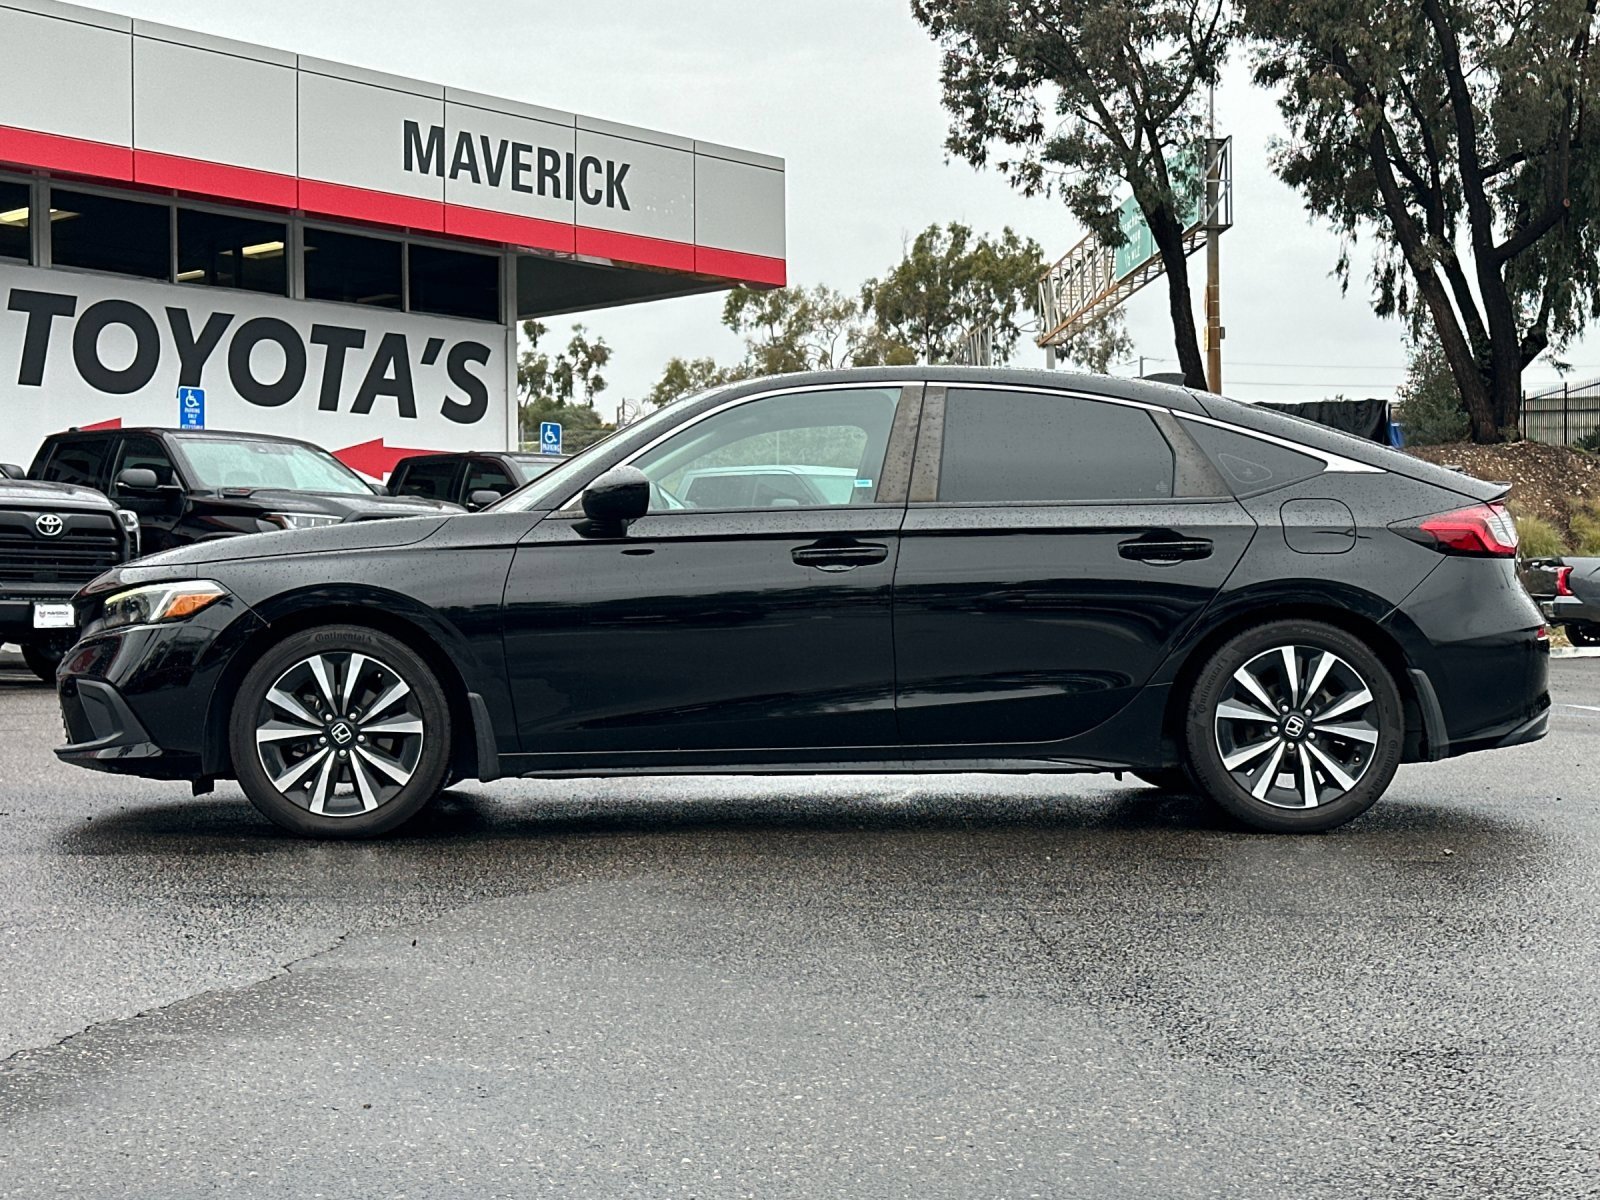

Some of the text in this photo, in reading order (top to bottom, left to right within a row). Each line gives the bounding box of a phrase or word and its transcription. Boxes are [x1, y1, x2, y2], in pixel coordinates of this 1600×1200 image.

[404, 119, 631, 211] MAVERICK
[8, 288, 491, 424] TOYOTA'S
[315, 630, 366, 644] Continental
